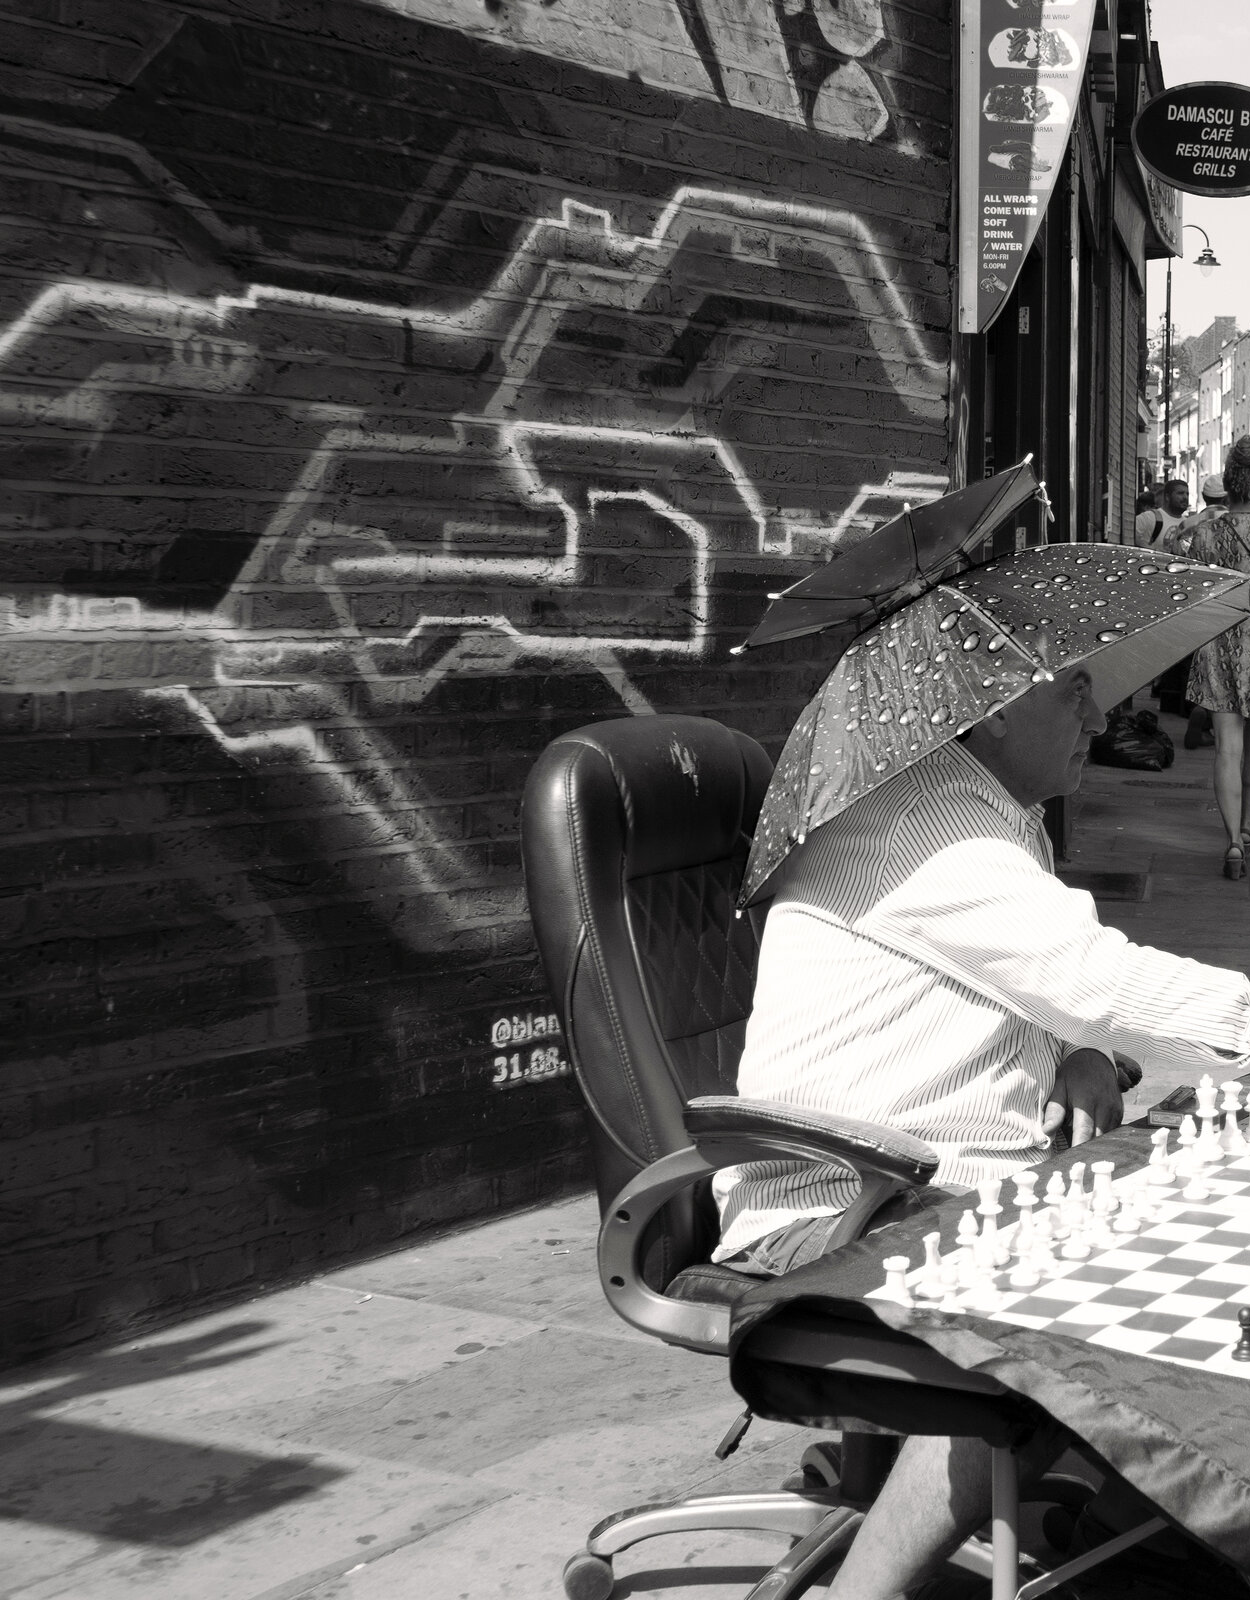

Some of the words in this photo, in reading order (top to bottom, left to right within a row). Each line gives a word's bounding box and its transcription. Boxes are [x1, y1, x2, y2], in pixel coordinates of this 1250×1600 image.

[1167, 104, 1234, 125] DAMASCU
[1200, 127, 1234, 142] CAFÉ
[1193, 162, 1237, 178] GRILLS
[983, 194, 1001, 203] ALL
[1003, 194, 1039, 204] WRAPS
[983, 206, 1012, 215] COME
[1013, 207, 1037, 216] WITH
[983, 218, 1007, 227] SOFT
[983, 230, 1014, 239] DRINK
[991, 242, 1023, 251] WATER
[983, 262, 1007, 270] 6.00PM
